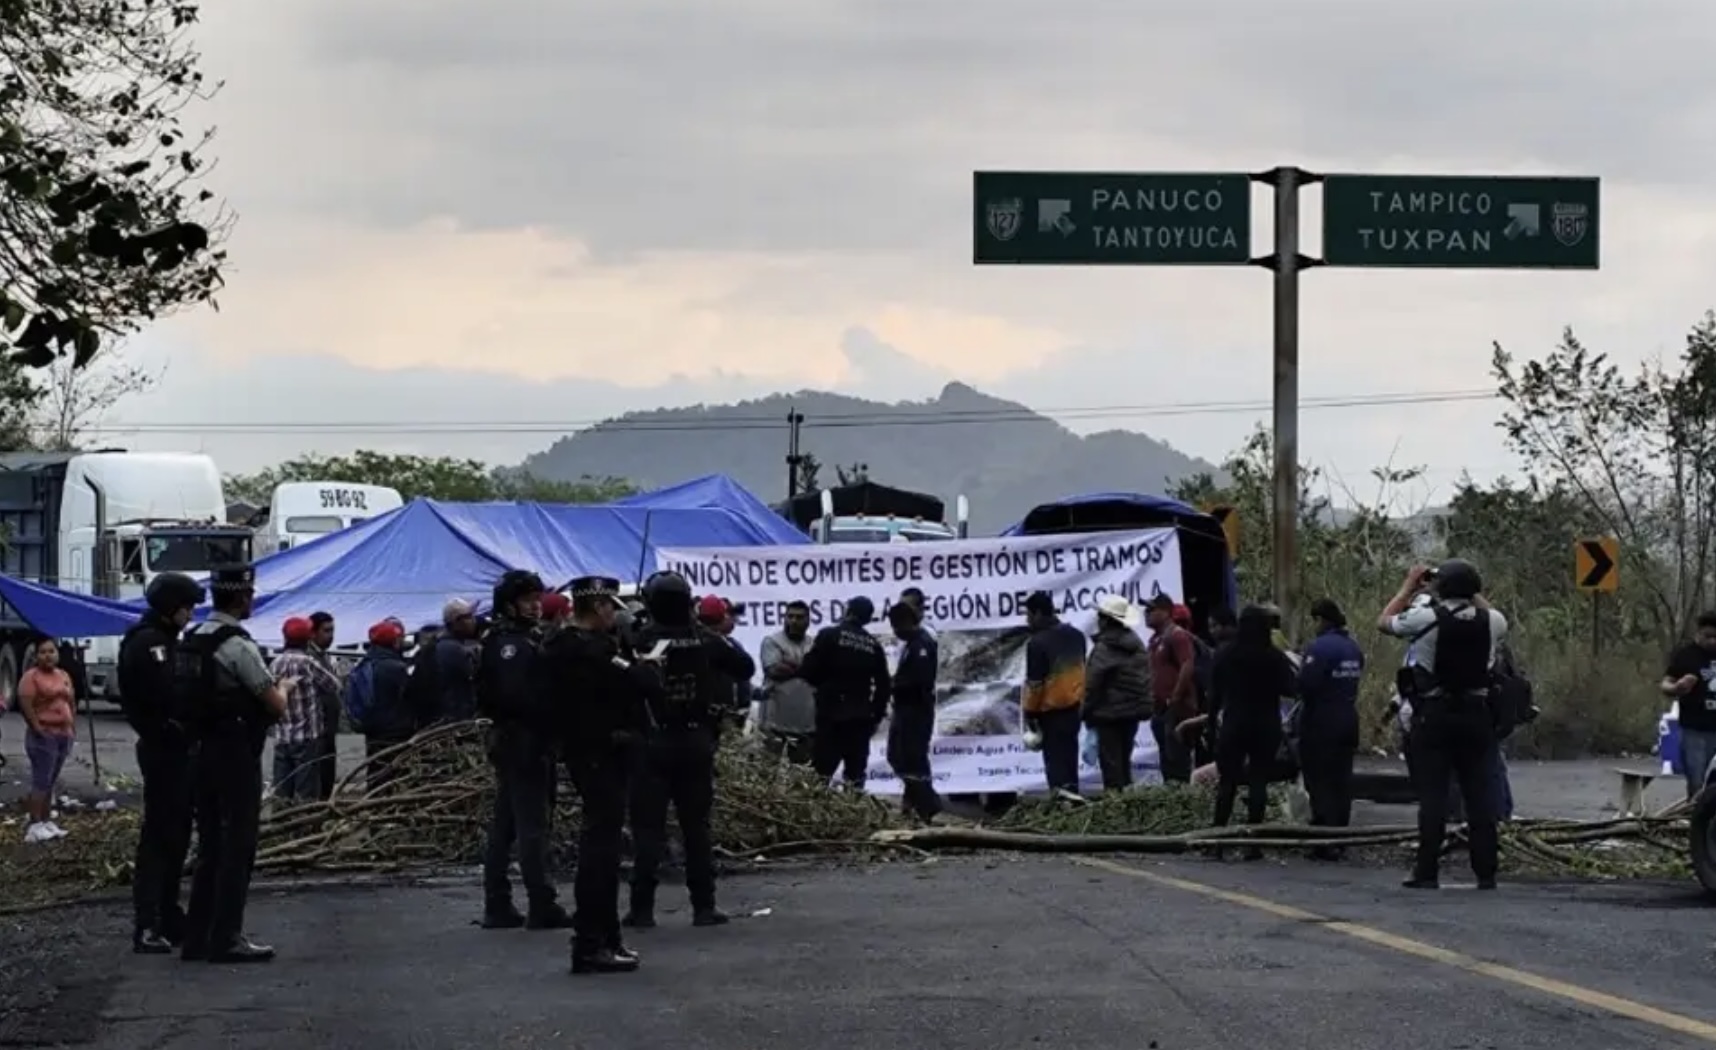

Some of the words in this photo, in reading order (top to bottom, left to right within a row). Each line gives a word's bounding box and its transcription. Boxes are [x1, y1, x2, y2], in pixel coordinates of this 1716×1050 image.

[1370, 191, 1492, 215] TAMPICO
[993, 211, 1016, 232] 127
[1092, 225, 1238, 249] TANTOYUCA
[1357, 228, 1492, 251] TUXPAN
[748, 559, 778, 586] DE
[785, 551, 885, 585] COMITÉS
[893, 554, 922, 581] DE
[929, 546, 1029, 580] GESTIÓN
[1035, 549, 1067, 575] DE
[1072, 541, 1163, 572] TRAMOS
[922, 587, 991, 620] EGIÓN
[998, 590, 1028, 618] DE
